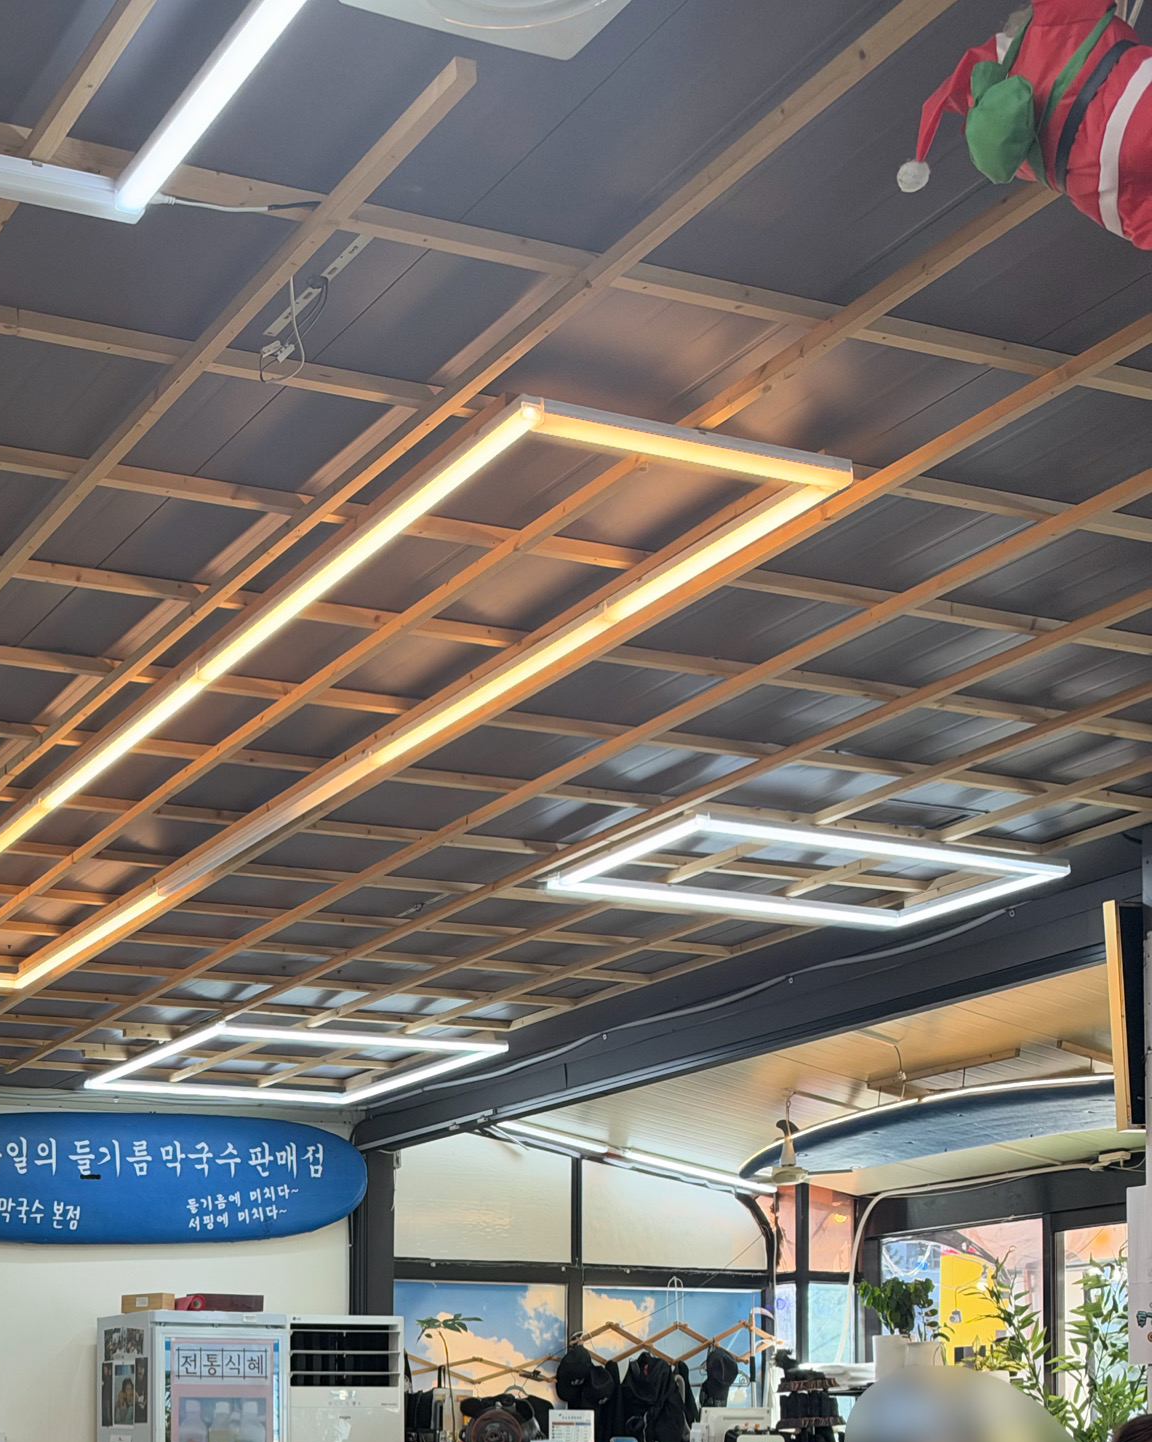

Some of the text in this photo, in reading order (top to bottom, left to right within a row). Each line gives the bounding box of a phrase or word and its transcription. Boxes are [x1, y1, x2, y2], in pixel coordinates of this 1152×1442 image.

[68, 1139, 153, 1177] 들기름
[160, 1140, 242, 1178] 막국수
[248, 1141, 324, 1179] 판매점
[186, 1184, 299, 1214] 들기름에 미치다~
[52, 1200, 81, 1231] 본점
[188, 1204, 288, 1231] 서핑에 미치다~
[180, 1353, 265, 1377] 전통식혜
